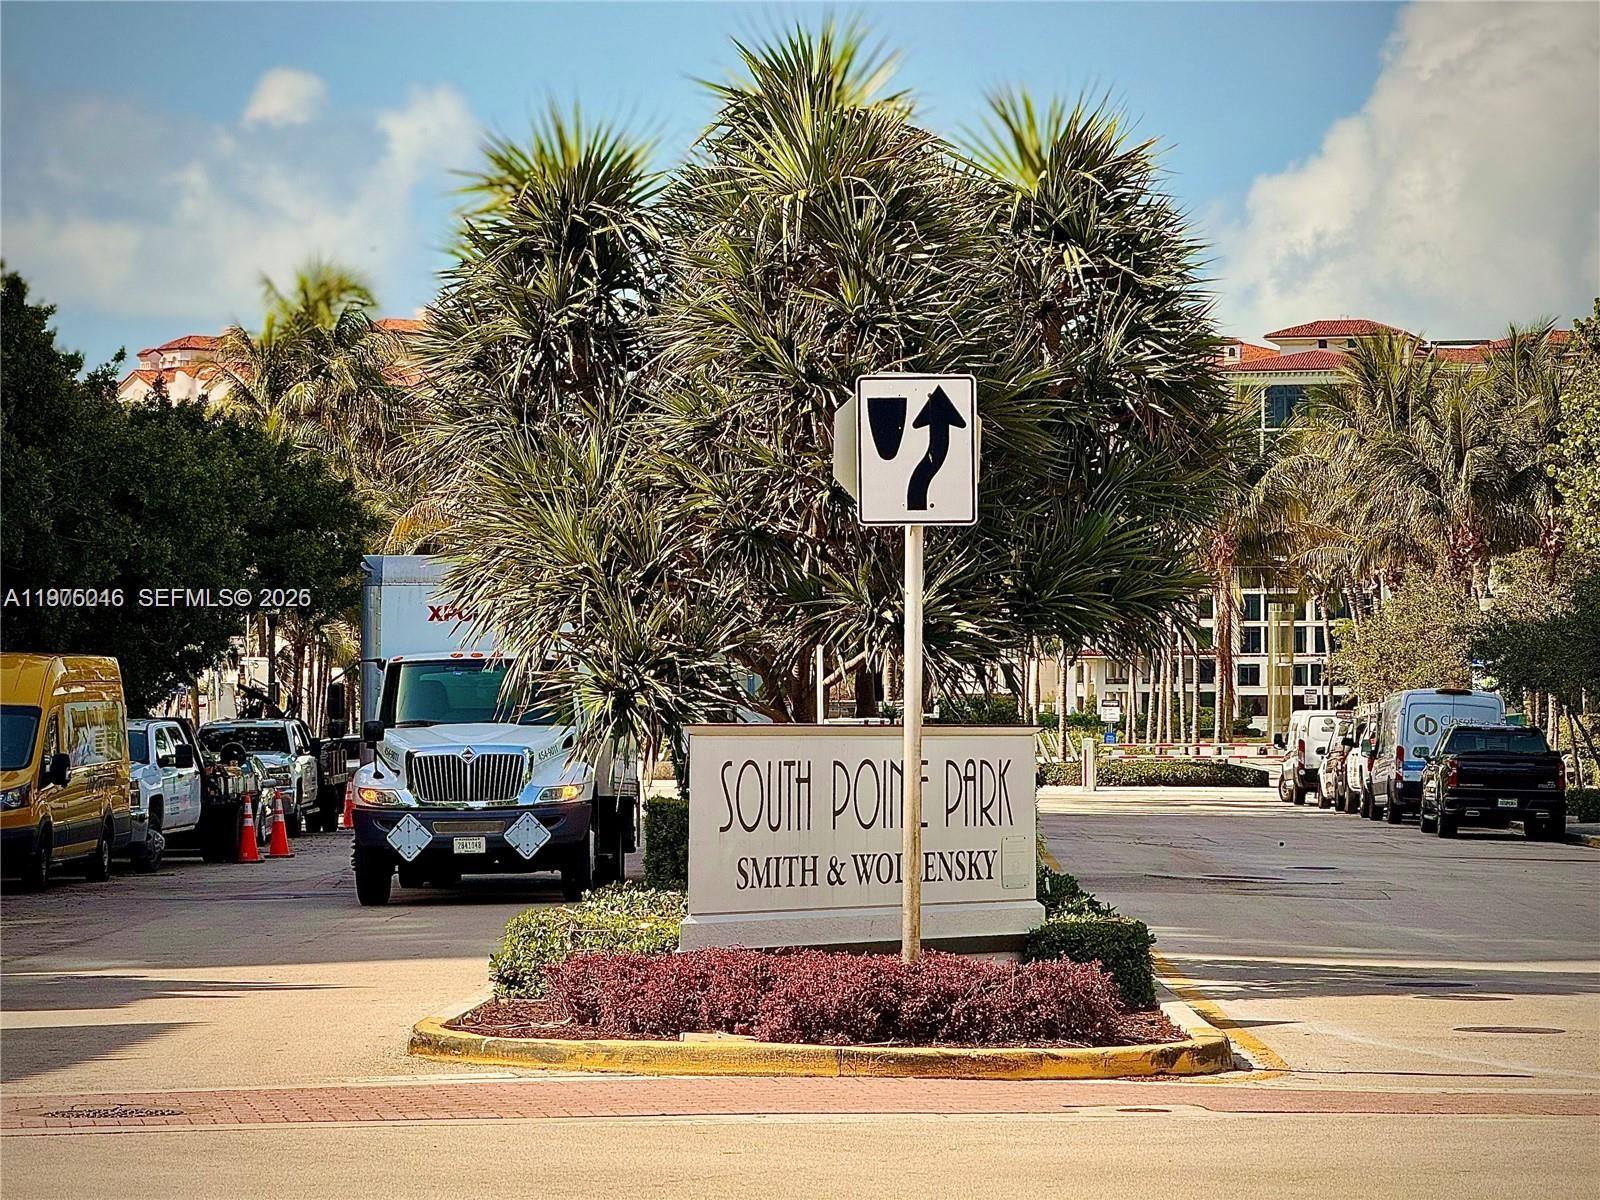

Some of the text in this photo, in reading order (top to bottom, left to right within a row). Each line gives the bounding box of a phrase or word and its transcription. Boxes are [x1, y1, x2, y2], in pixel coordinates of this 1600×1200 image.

[719, 758, 1014, 833] SOUTH POINE PARK
[736, 855, 819, 890] SMITH
[827, 855, 847, 887] &
